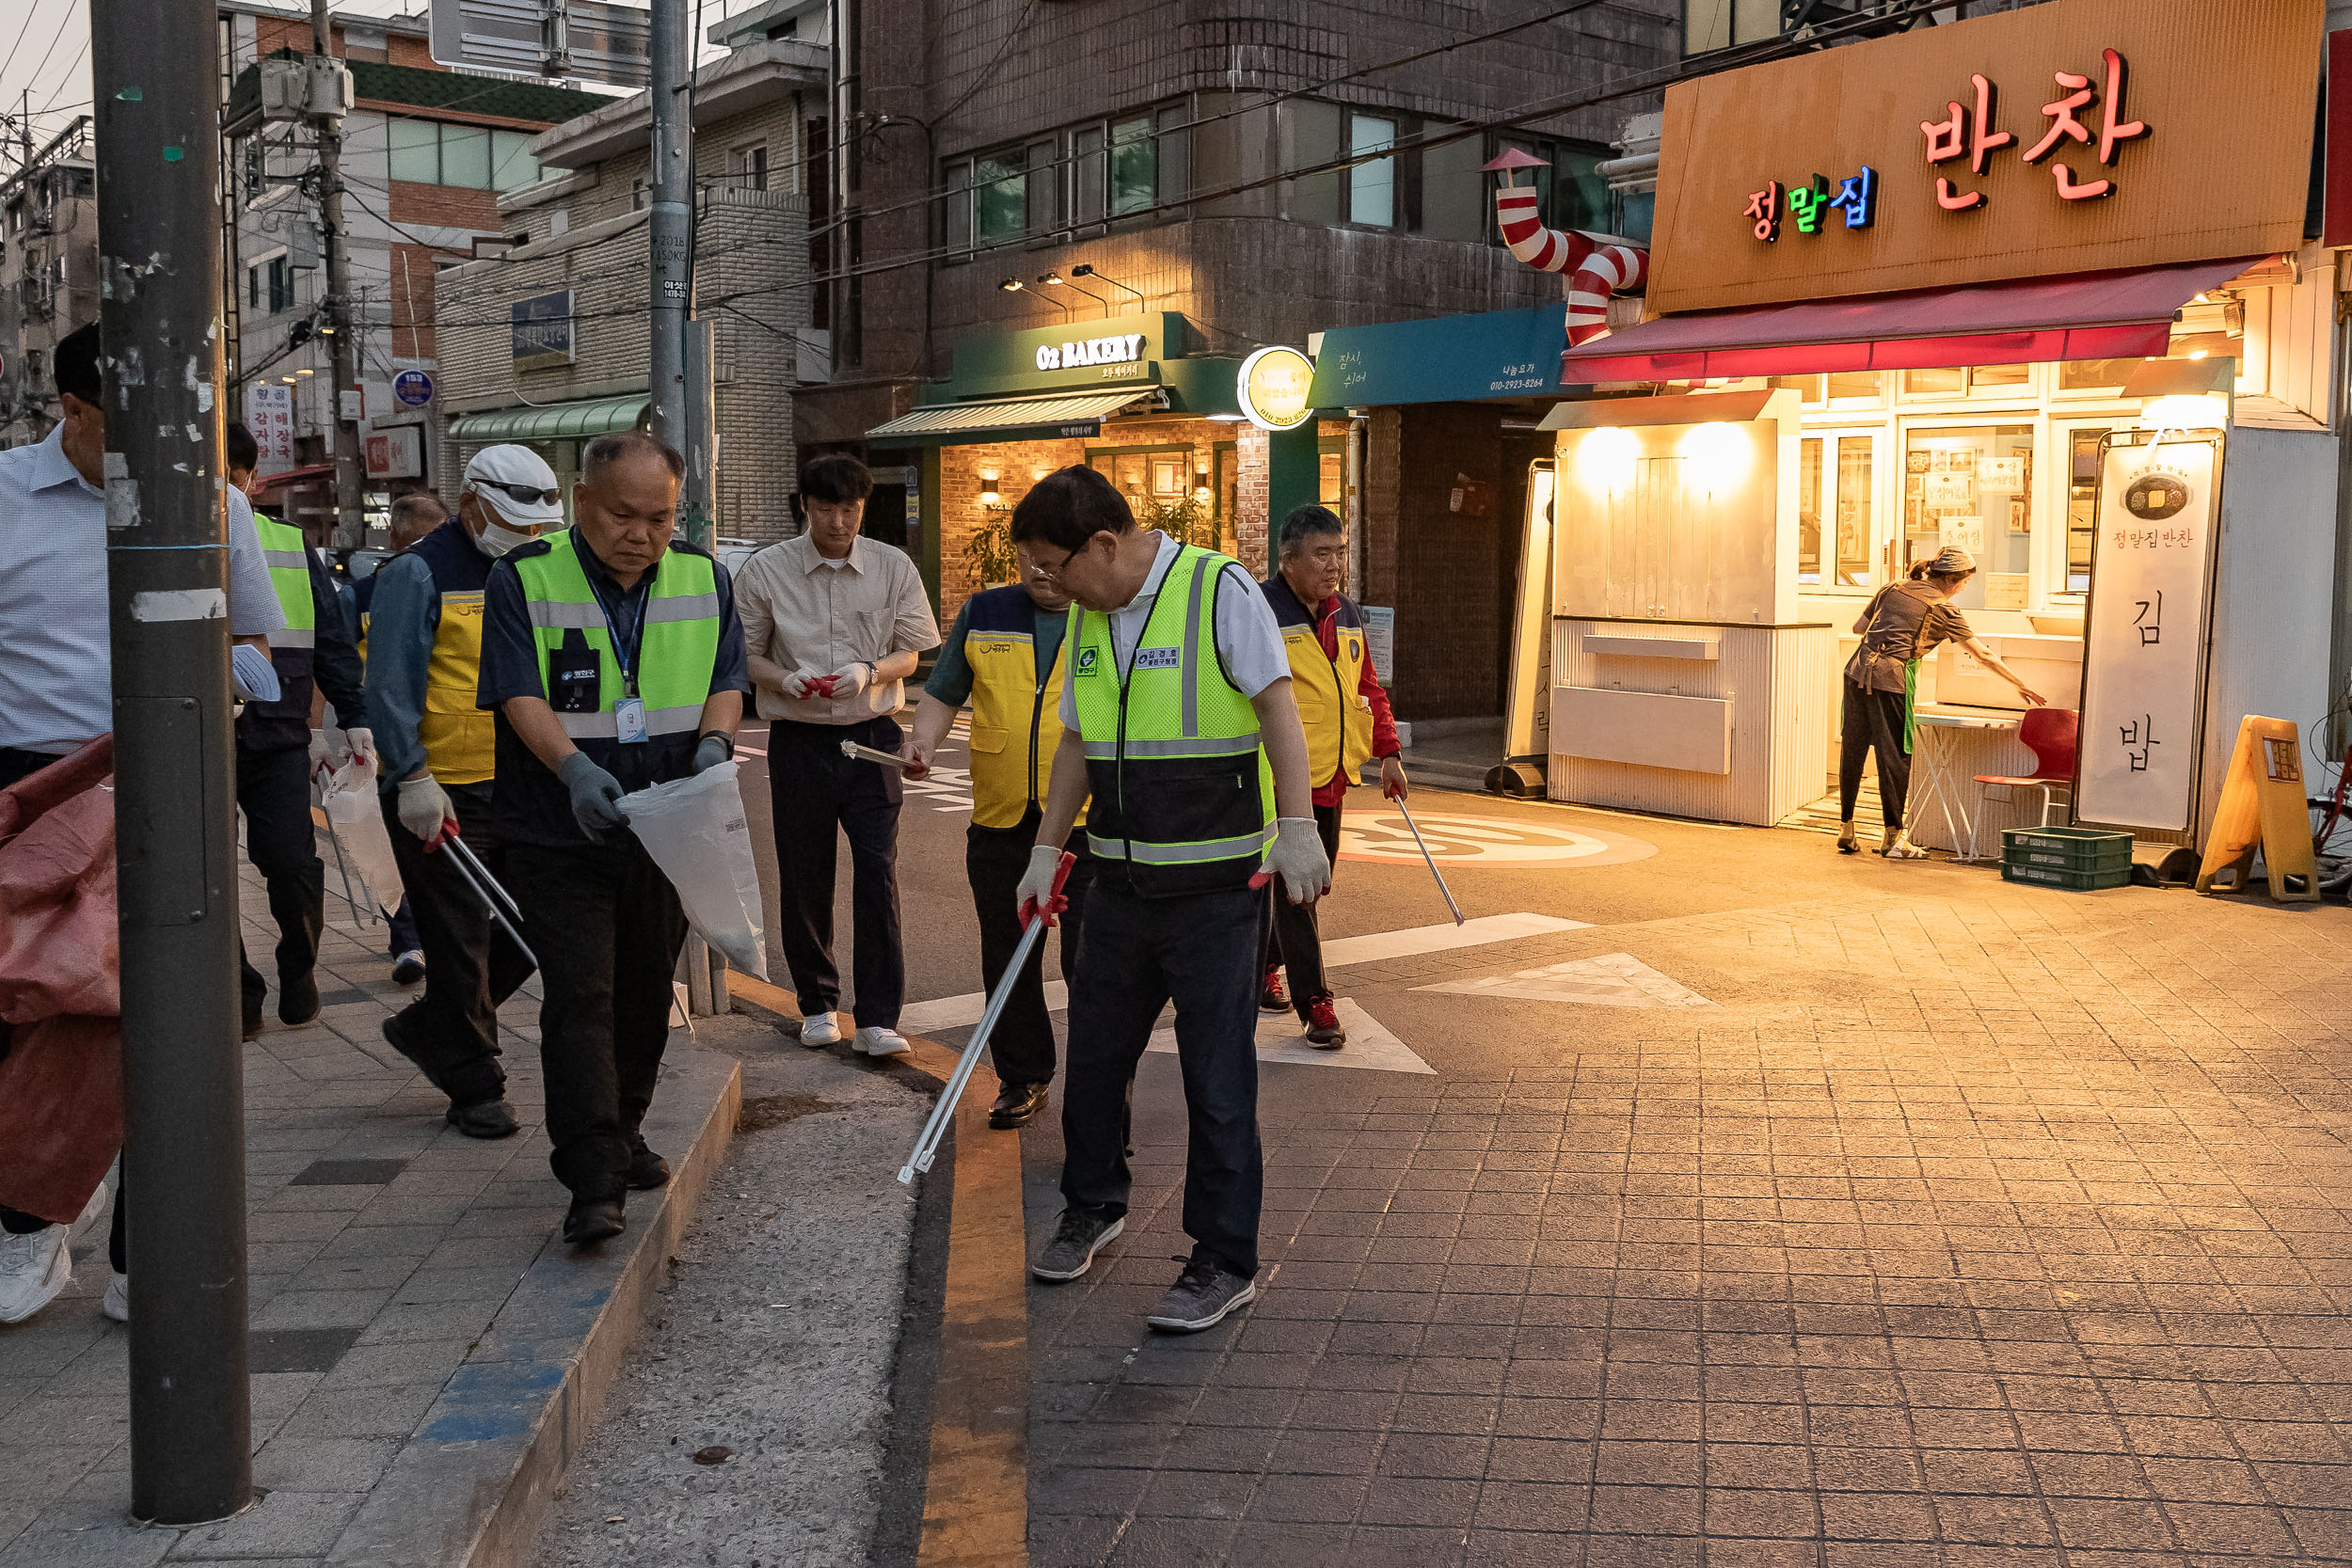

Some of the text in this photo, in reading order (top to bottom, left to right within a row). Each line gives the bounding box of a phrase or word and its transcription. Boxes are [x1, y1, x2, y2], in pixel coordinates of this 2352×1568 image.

[1743, 48, 2145, 241] 정말집 반찬
[1061, 333, 1142, 368] BAKERY
[1502, 362, 1535, 376] 나눔요가
[1489, 377, 1544, 391] 010-2923-8264
